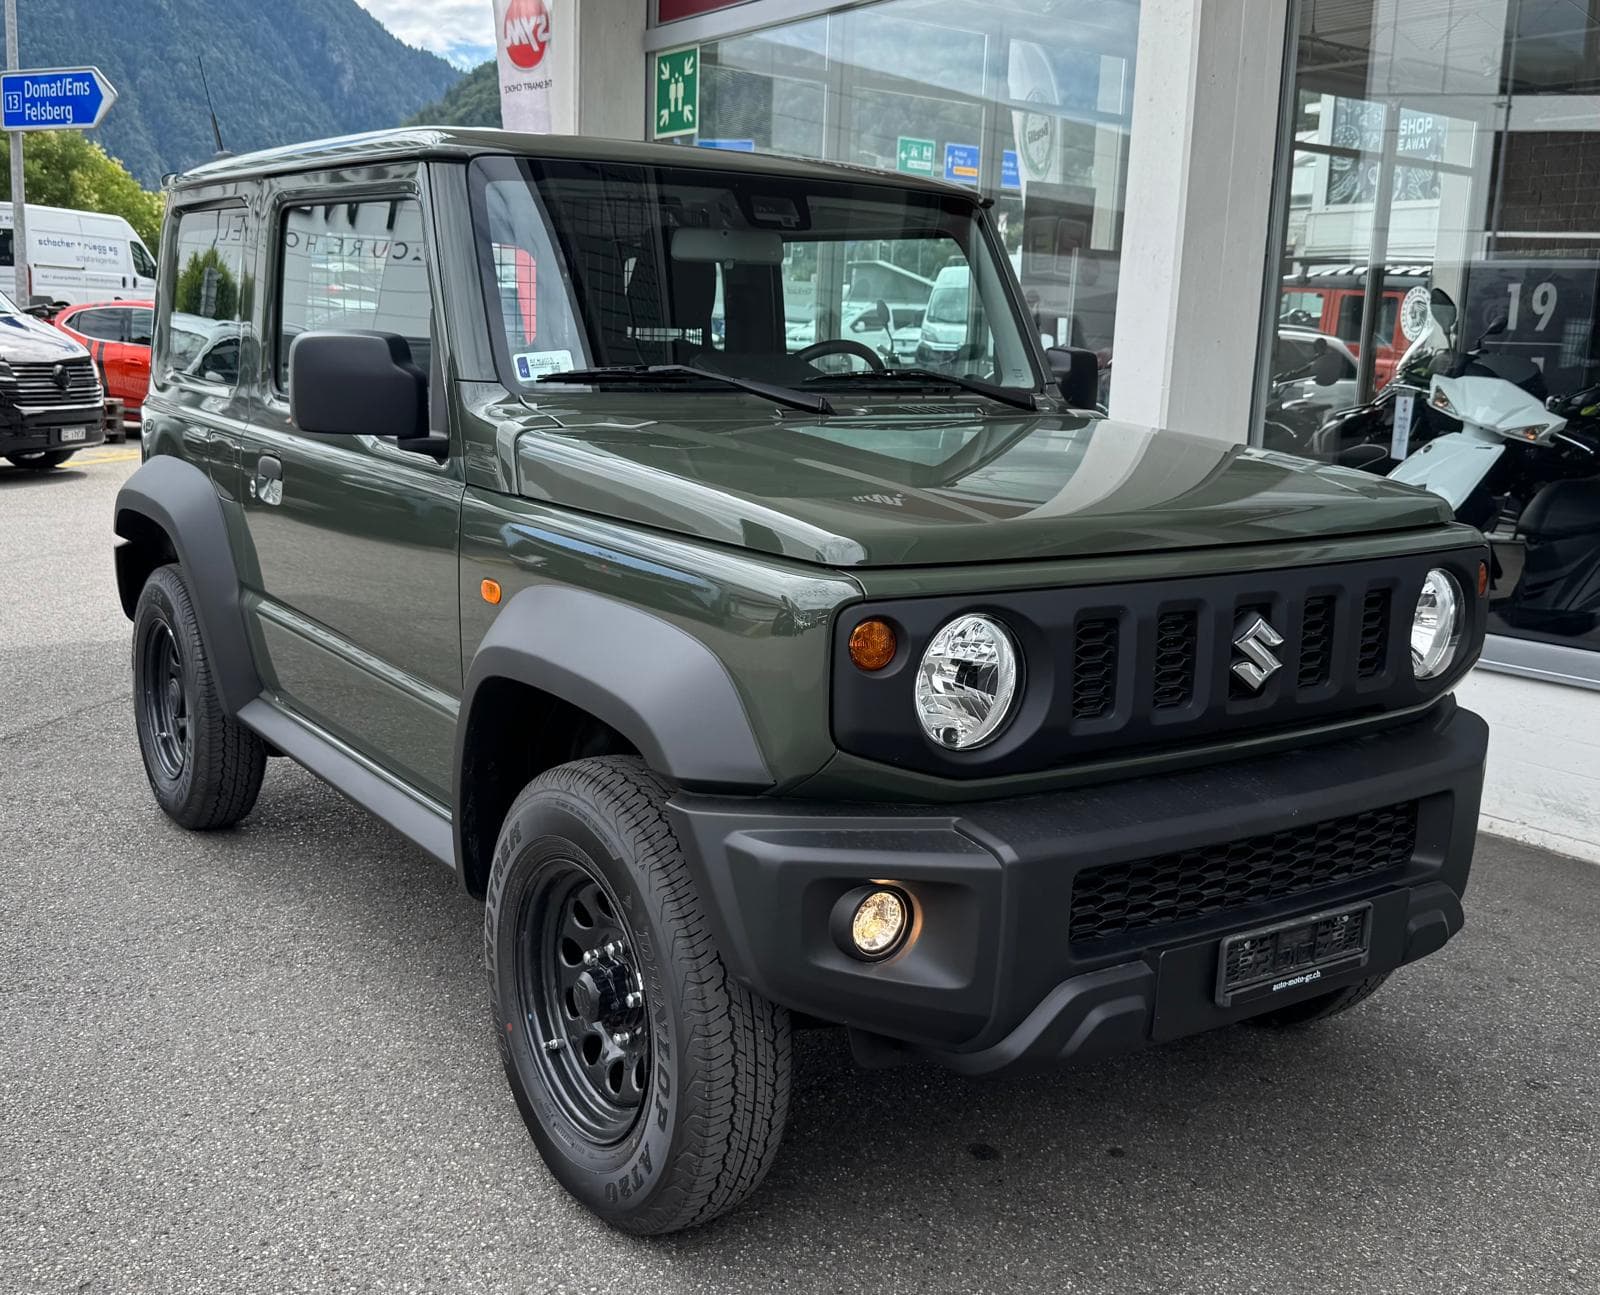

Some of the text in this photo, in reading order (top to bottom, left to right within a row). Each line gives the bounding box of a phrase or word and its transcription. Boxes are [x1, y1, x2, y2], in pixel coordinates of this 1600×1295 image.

[24, 77, 91, 98] Domat/Ems
[7, 94, 20, 110] 13
[25, 100, 74, 124] Felsberg
[1400, 117, 1433, 136] SHOP
[1506, 281, 1558, 332] 19
